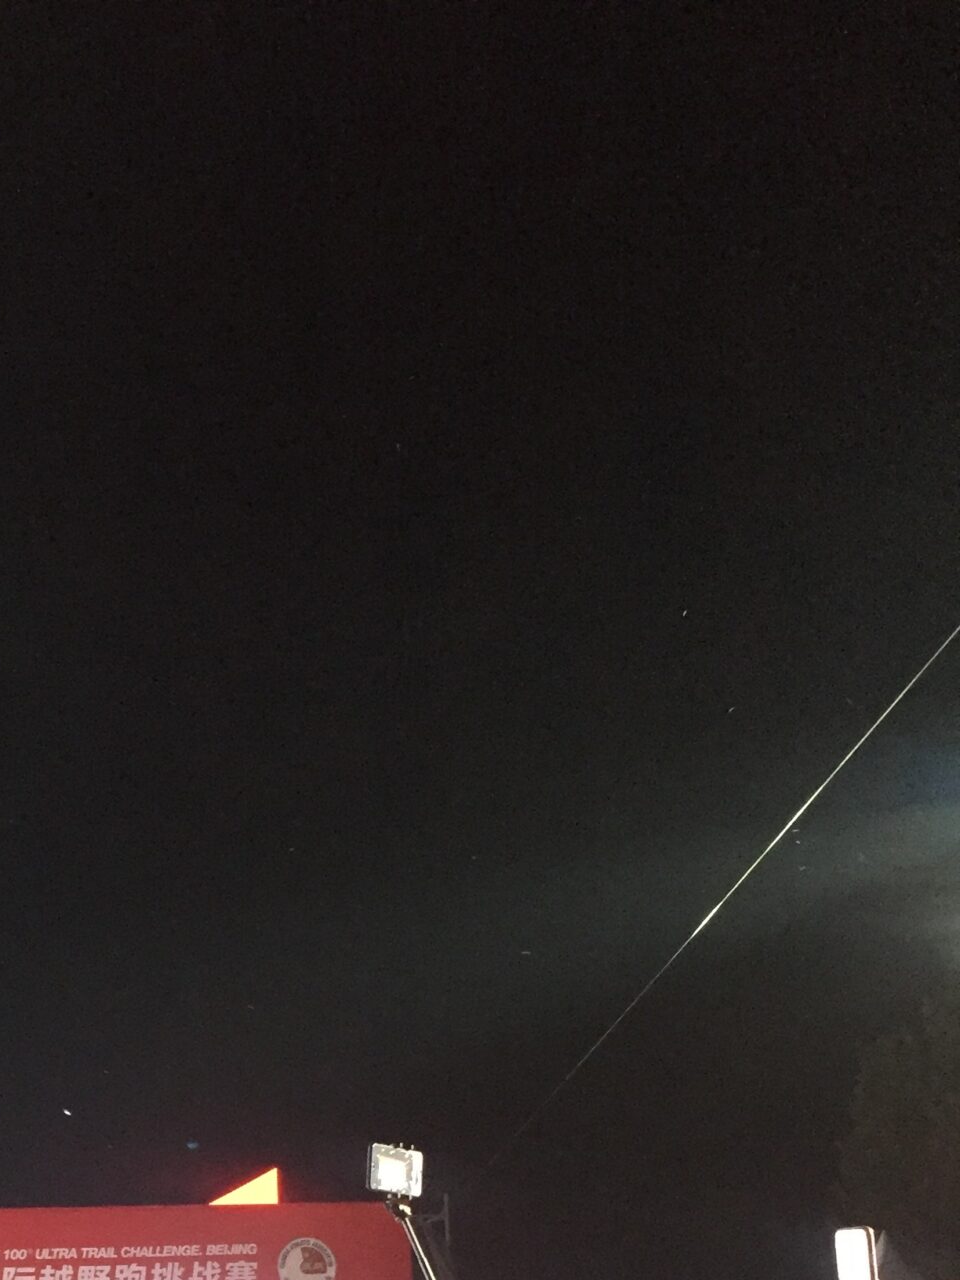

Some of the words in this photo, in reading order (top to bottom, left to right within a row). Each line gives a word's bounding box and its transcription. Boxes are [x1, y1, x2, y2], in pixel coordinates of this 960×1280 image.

[35, 1247, 78, 1260] ULTRA
[81, 1247, 117, 1259] TRAIL
[205, 1243, 257, 1256] BEIJING
